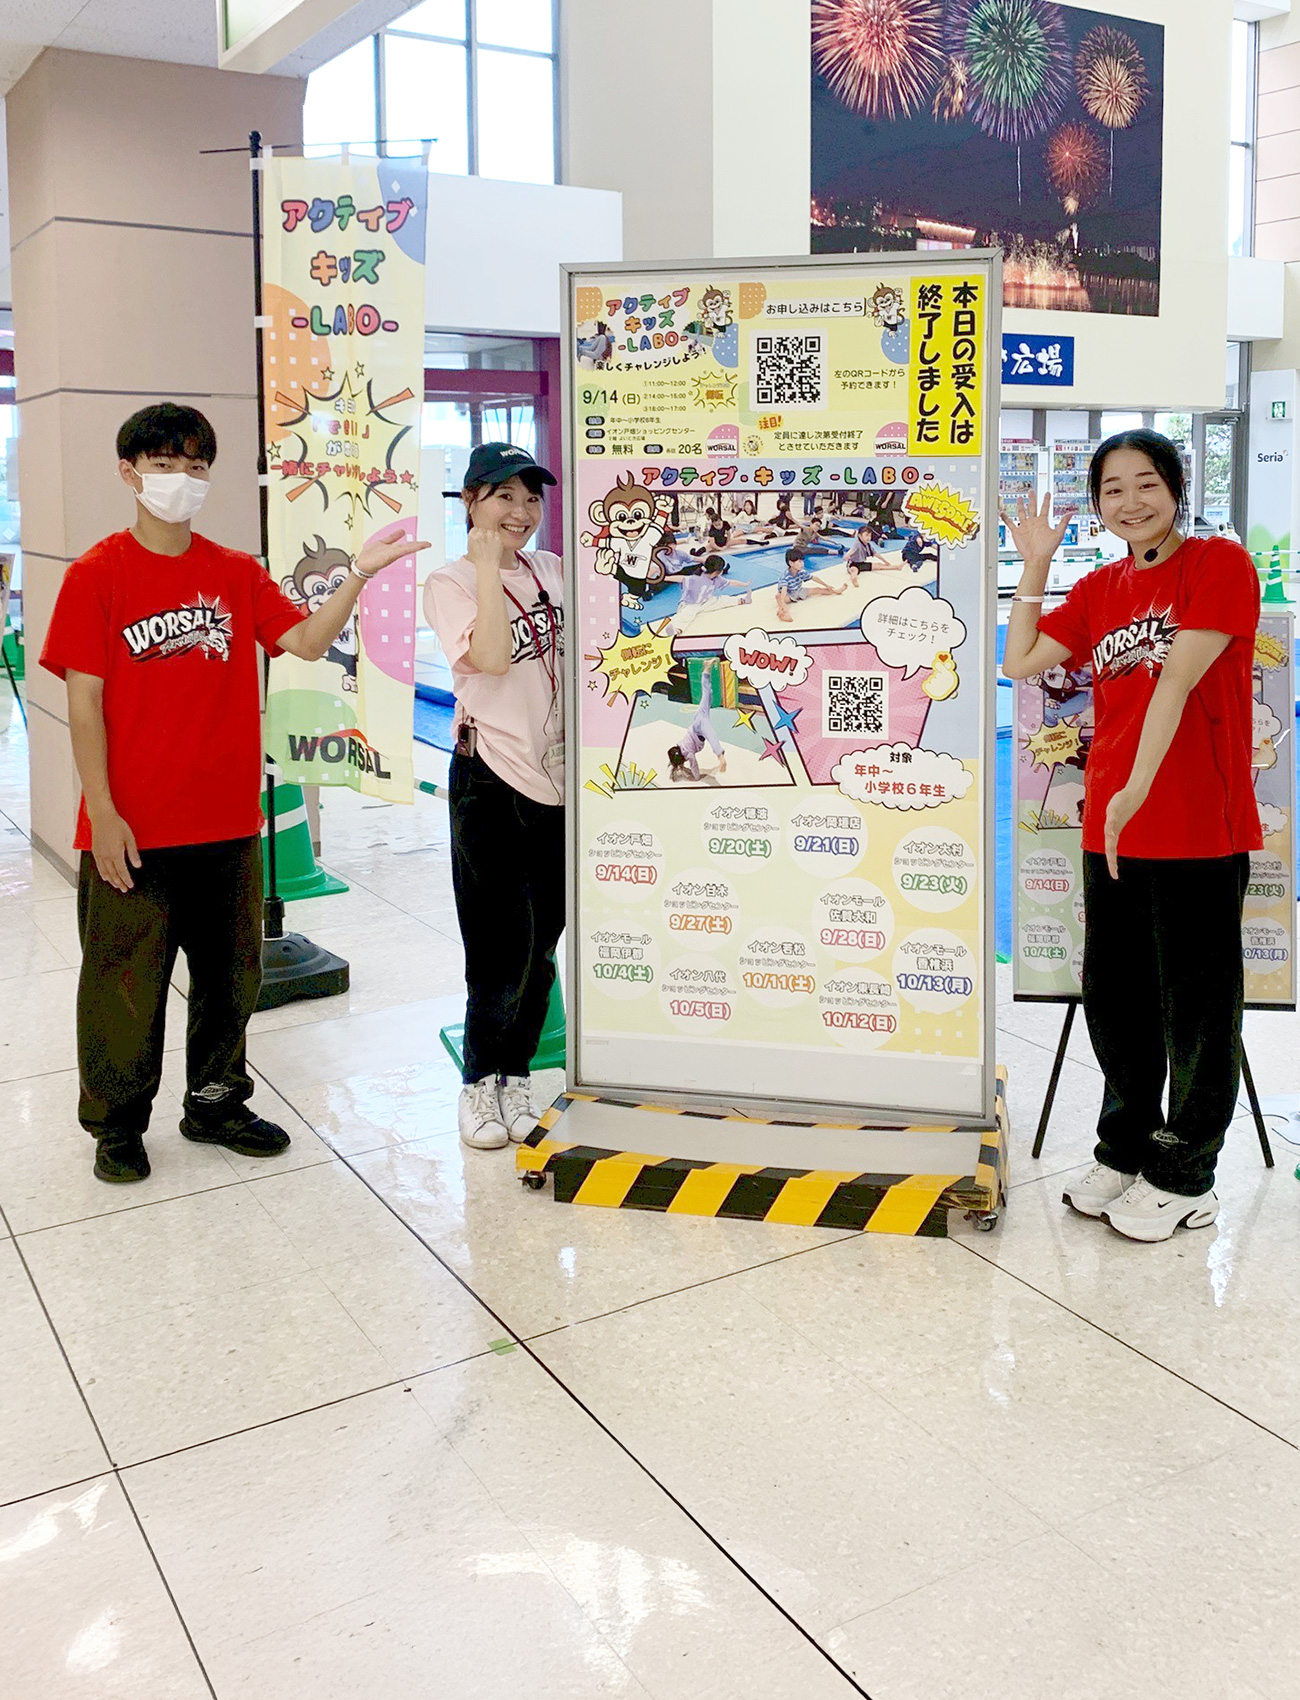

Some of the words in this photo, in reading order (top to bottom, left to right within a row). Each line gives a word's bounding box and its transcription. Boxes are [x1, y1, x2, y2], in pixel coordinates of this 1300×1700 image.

[281, 195, 414, 233] アクティブ
[310, 250, 386, 287] キッズ
[606, 287, 691, 317] アクティブ
[766, 302, 863, 314] お申し込みはこちら
[291, 303, 399, 337] -LABO-
[624, 309, 675, 334] キッズ
[618, 331, 689, 353] -LABO-
[916, 283, 944, 443] 終了しました
[950, 281, 979, 444] 本日の受入は
[1001, 343, 1063, 377] 広場
[834, 369, 906, 379] 左のQRコードから
[612, 444, 634, 455] 無料
[678, 443, 702, 455] 20名
[707, 443, 737, 452] WORSAL
[778, 442, 859, 451] とさせていただきます
[875, 441, 906, 450] WORSAL
[1257, 452, 1284, 462] Seria
[122, 609, 216, 655] WORSAL
[877, 612, 950, 634] 詳細はこちらを
[738, 647, 799, 677] WOW!
[289, 734, 391, 780] WORSAL
[890, 752, 913, 764] 対象
[709, 838, 772, 858] 9/20(土)
[794, 836, 859, 856] 9/21(日)
[595, 864, 658, 885] 9/14(日)
[901, 873, 967, 895] 9/23(火)
[1025, 878, 1069, 892] 9/14(日)
[820, 893, 885, 908] イオンモール
[669, 914, 732, 935] 9/27(土)
[591, 931, 652, 945] イオンモール
[820, 929, 885, 950] 9/28(日)
[900, 942, 967, 958] イオンモール
[1023, 946, 1067, 960] 10/4(土)
[593, 963, 653, 983] 10/4(土)
[742, 972, 816, 994] 10/11(土)
[896, 973, 973, 996] 10/13(月)
[670, 1000, 731, 1021] 10/5(日)
[822, 1011, 897, 1033] 10/12(日)
